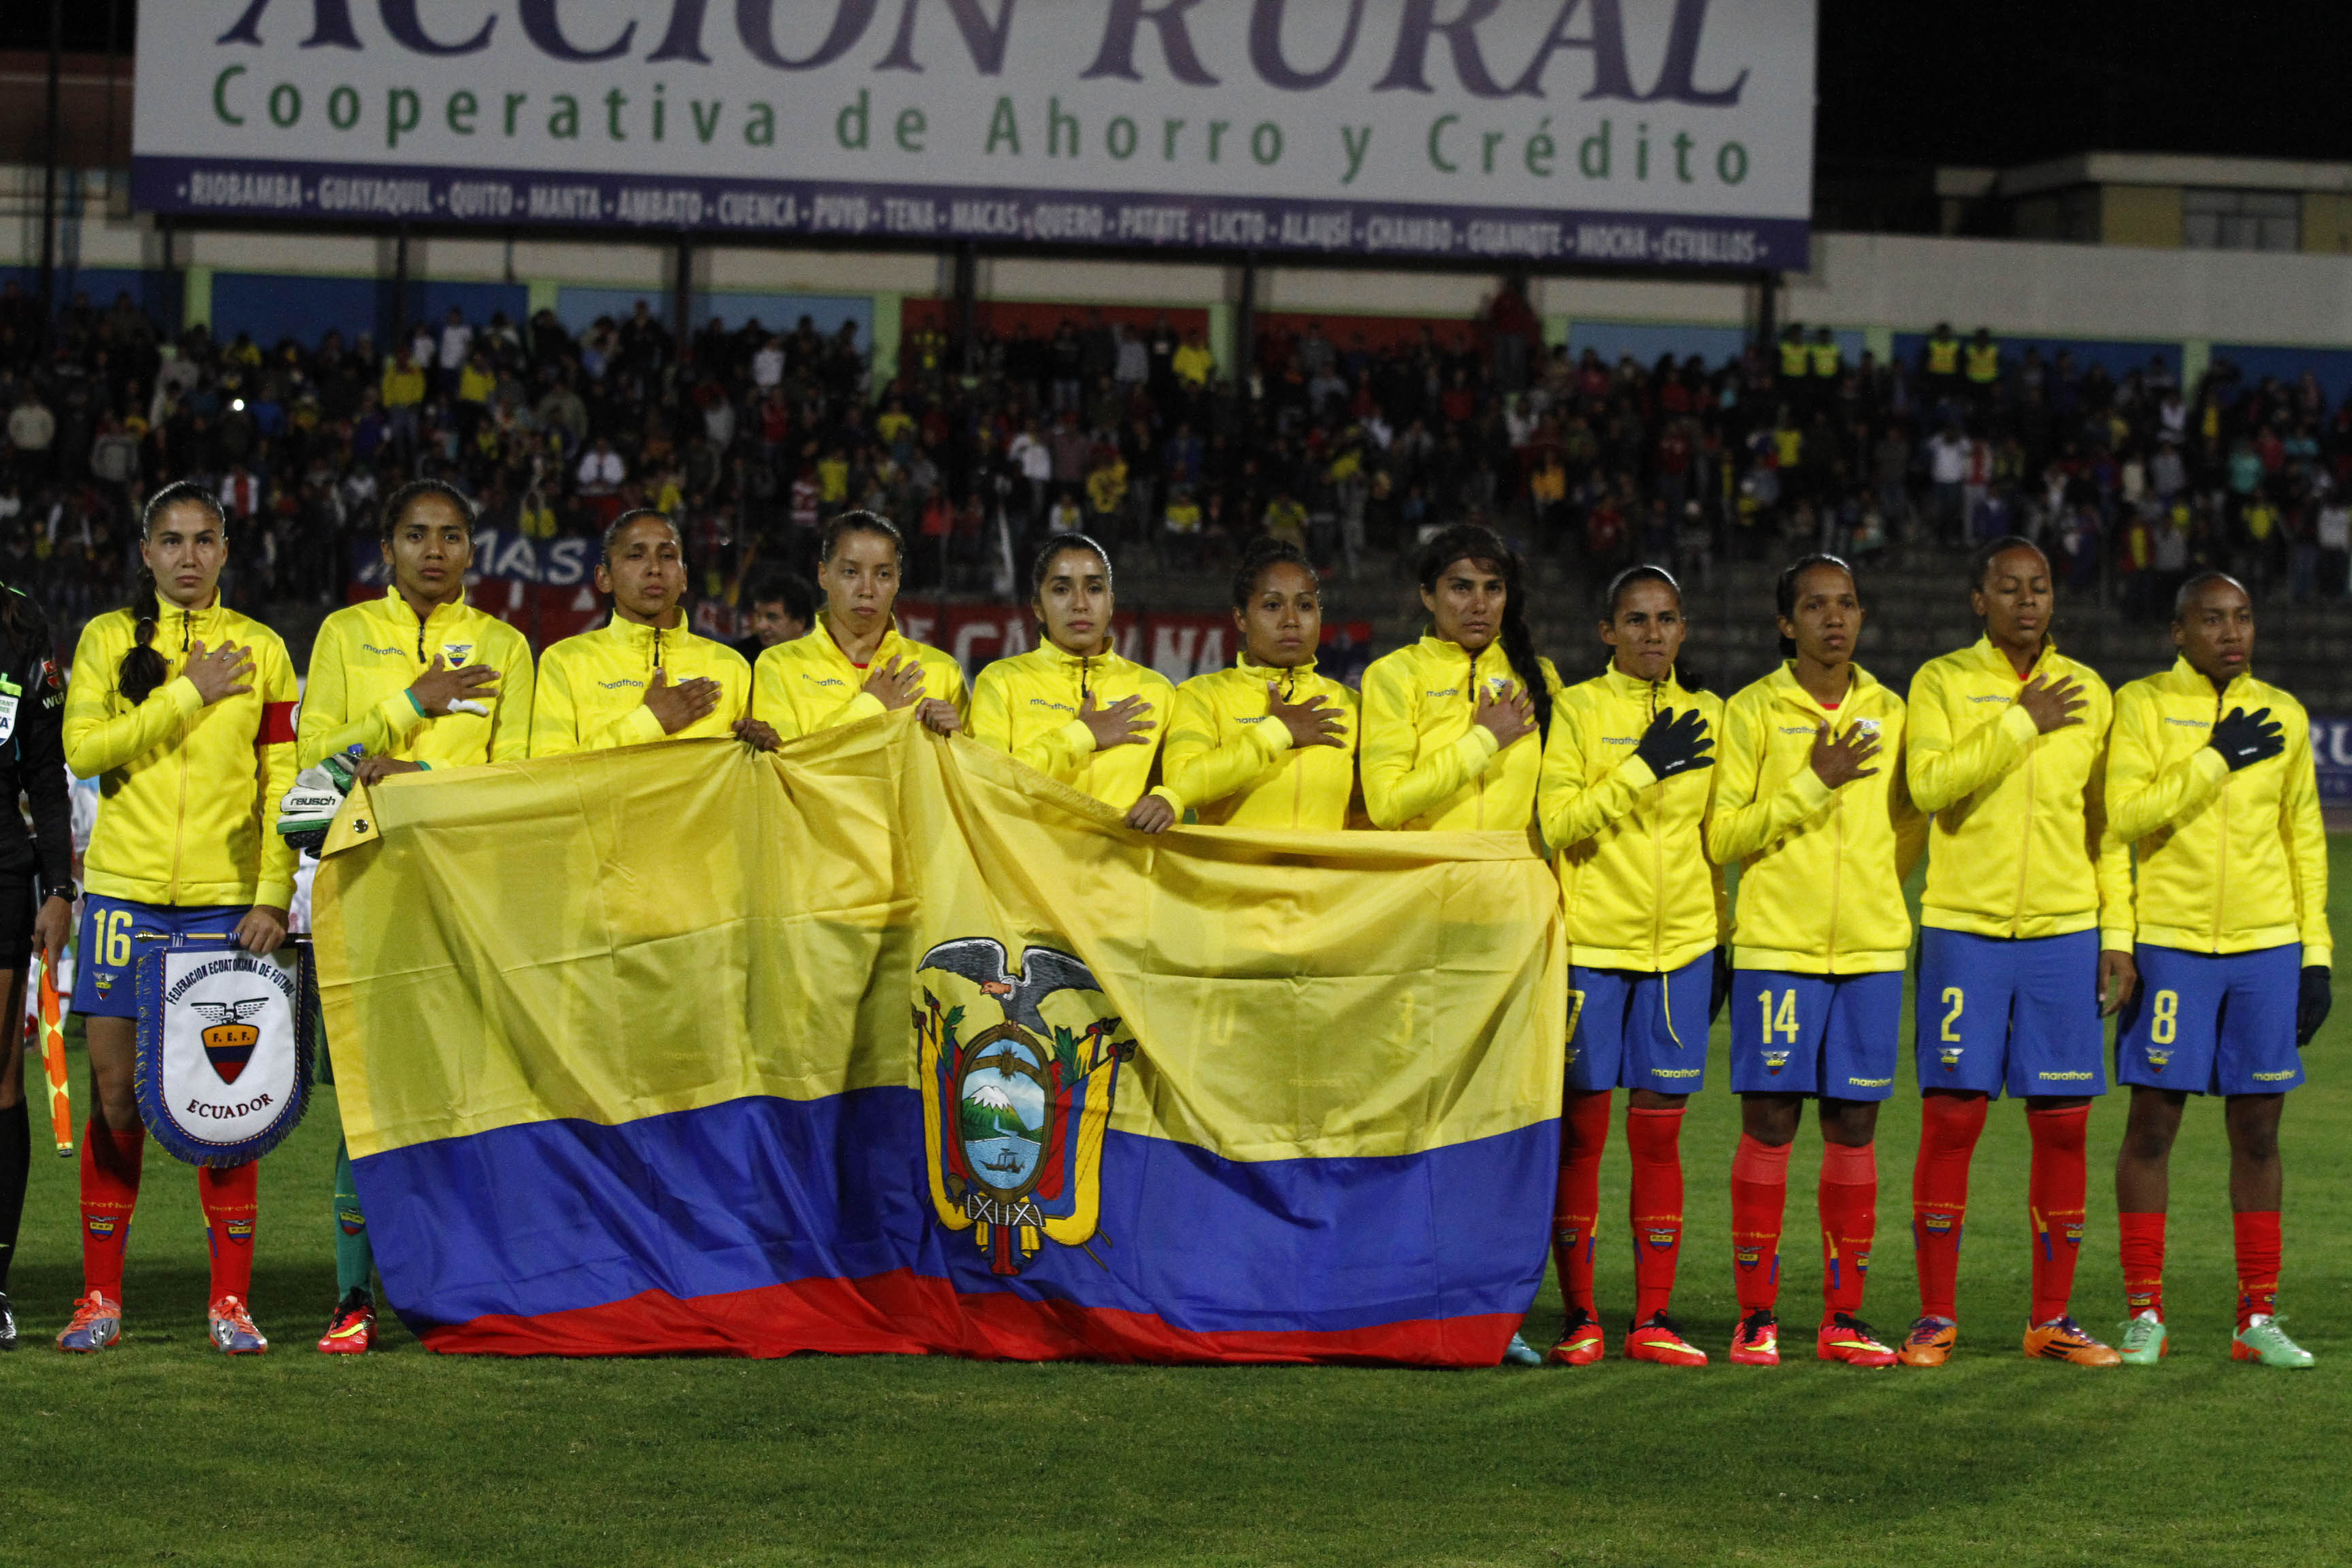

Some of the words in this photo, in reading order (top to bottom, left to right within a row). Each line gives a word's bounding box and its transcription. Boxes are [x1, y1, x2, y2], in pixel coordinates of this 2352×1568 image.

[213, 63, 776, 148] Cooperativa
[836, 88, 927, 152] de
[985, 95, 1284, 166] Ahorro
[1339, 125, 1372, 184] y
[1427, 113, 1751, 186] Crédito
[191, 170, 301, 208] RIOBAMBA
[318, 176, 431, 216] GUAYAQUIL
[448, 181, 512, 218] QUITO
[528, 186, 601, 220] MANTA
[616, 188, 702, 227] AMBATO
[717, 191, 797, 227] CUENCA
[812, 194, 868, 233] PUYO
[884, 199, 936, 231] TENA
[950, 200, 1019, 235] MACAS
[1033, 204, 1103, 240] QUERO
[1118, 206, 1189, 242] PATATE
[1209, 210, 1265, 244] LICTO
[290, 796, 336, 806] reusch
[94, 909, 133, 966] 16
[165, 964, 208, 1005] FEDERACION
[208, 958, 258, 975] ECUATORIANA
[258, 963, 270, 978] DE
[270, 968, 295, 998] FUTBOL
[1758, 989, 1799, 1044] 14
[1941, 987, 1963, 1042] 2
[2151, 990, 2178, 1045] 8
[1651, 1068, 1700, 1078] marathon
[2039, 1071, 2093, 1081] marathon
[186, 1093, 274, 1120] ECUADOR
